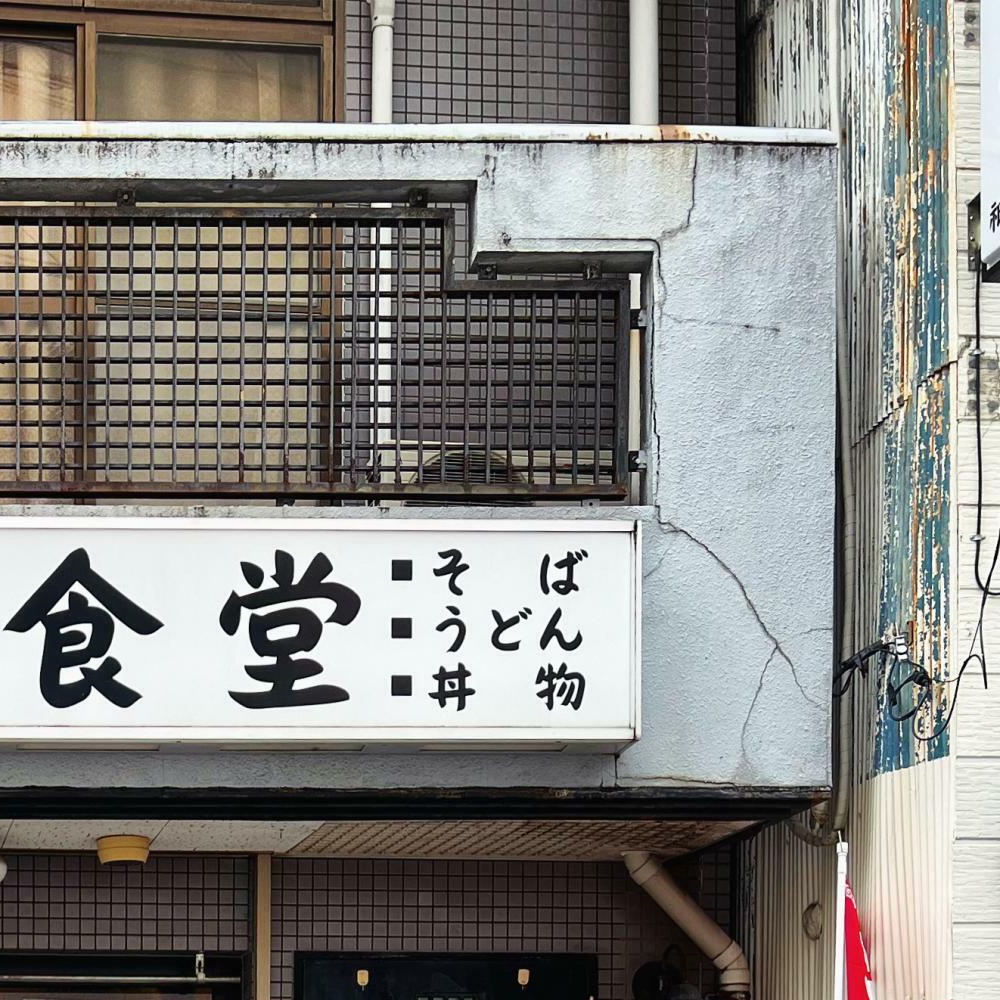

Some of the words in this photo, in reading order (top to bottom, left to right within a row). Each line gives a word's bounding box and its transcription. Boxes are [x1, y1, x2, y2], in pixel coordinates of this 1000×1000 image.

[432, 548, 588, 597] そば
[435, 605, 583, 652] うどん
[427, 661, 585, 711] 丼物
